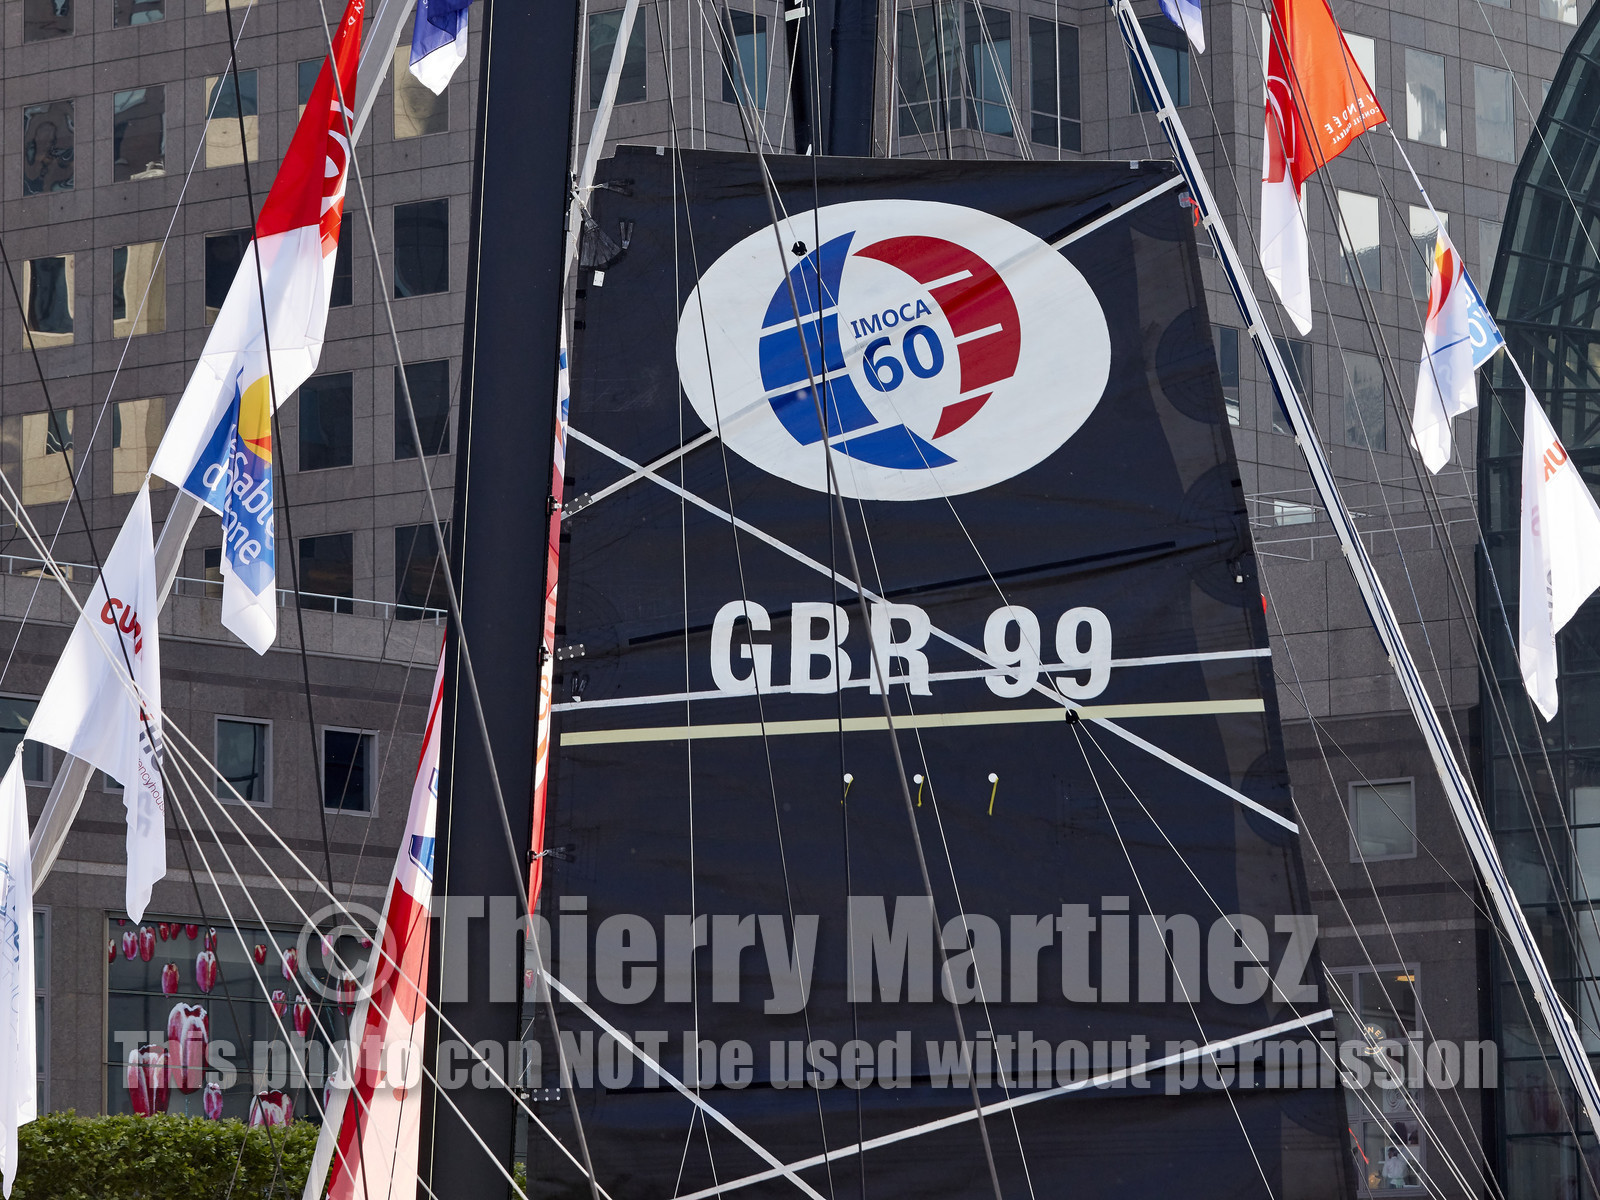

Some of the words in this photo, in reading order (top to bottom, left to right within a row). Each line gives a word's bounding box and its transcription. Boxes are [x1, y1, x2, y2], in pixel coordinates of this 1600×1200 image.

[850, 298, 932, 339] IMOCA
[863, 324, 945, 393] 60
[710, 600, 933, 696] GBR
[983, 605, 1113, 700] 99
